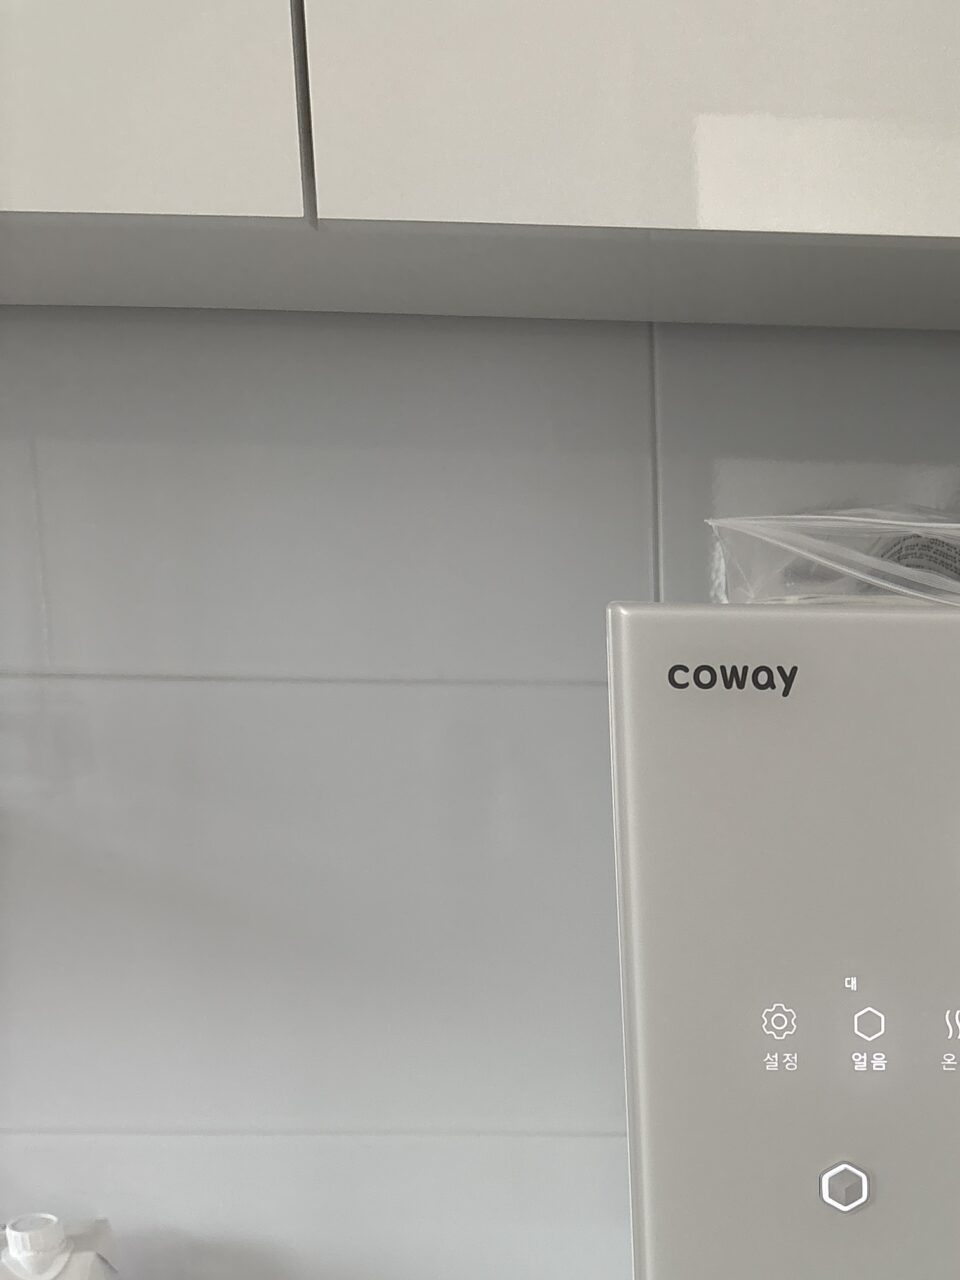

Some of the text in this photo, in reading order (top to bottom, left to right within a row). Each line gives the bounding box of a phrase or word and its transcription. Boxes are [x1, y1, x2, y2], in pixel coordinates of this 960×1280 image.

[668, 664, 798, 697] coway
[844, 976, 857, 991] 대
[764, 1052, 798, 1071] 설정
[851, 1052, 888, 1071] 얼음
